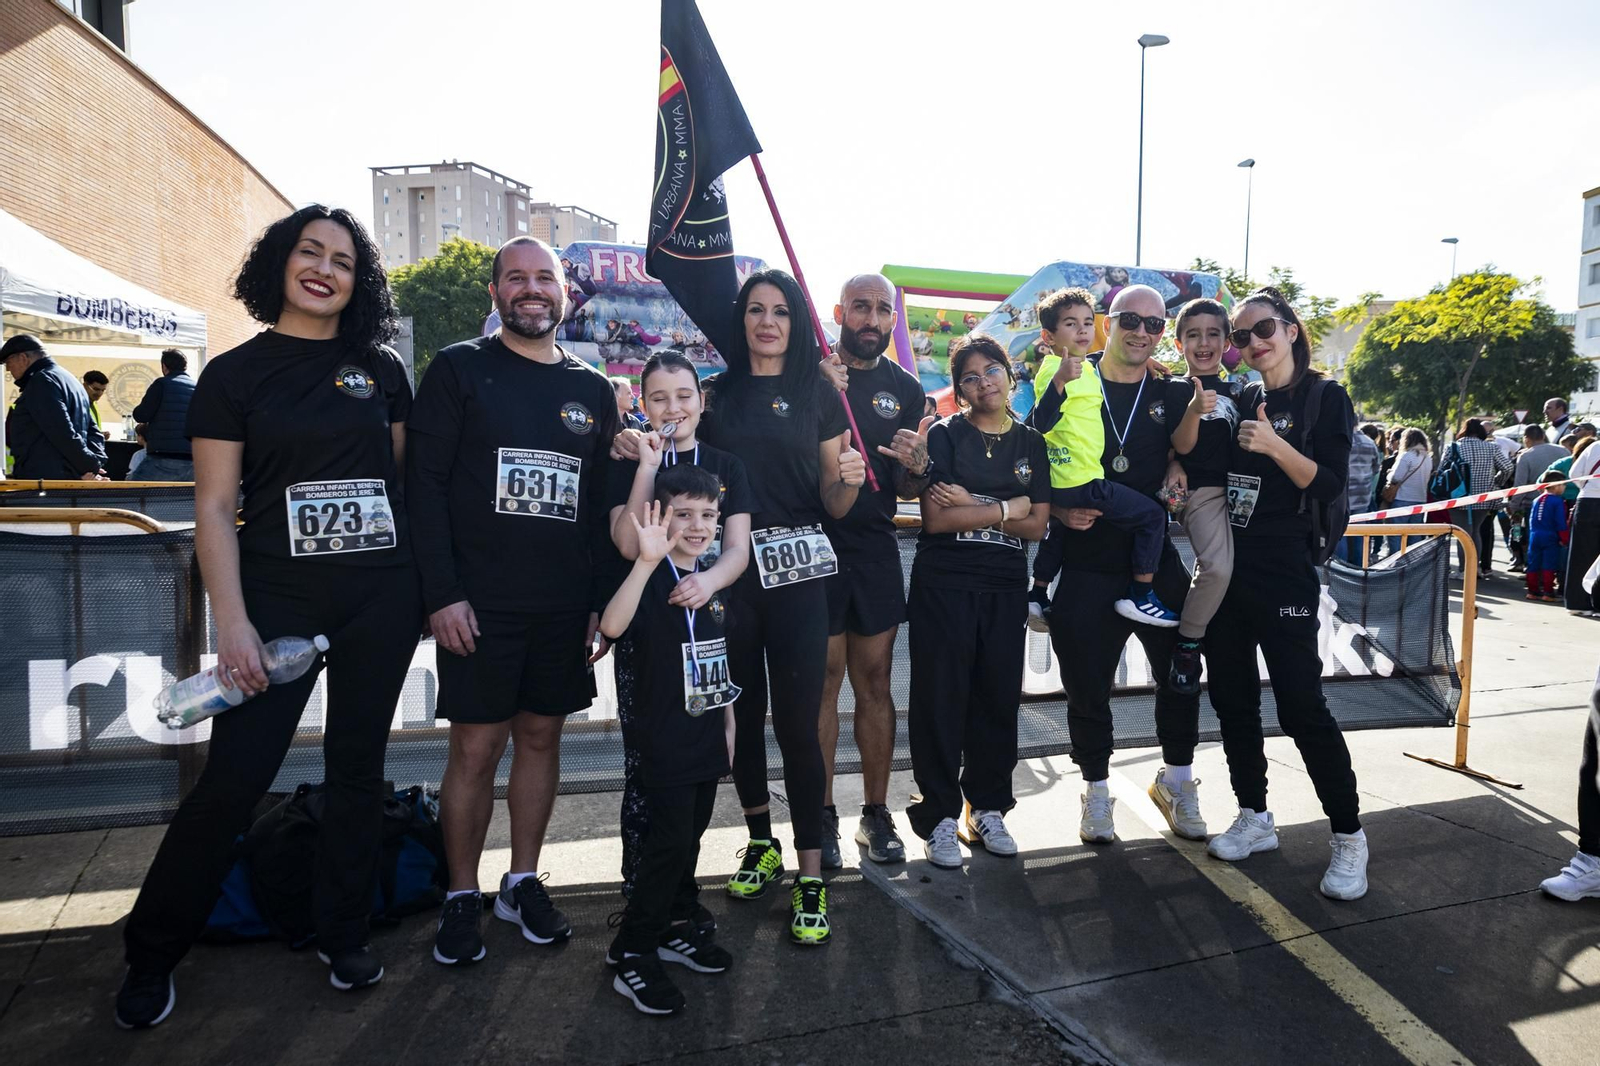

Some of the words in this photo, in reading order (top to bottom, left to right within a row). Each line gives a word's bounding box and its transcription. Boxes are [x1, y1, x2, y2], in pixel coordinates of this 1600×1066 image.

[672, 103, 688, 145] MMA
[657, 161, 688, 220] URBANA
[502, 451, 533, 459] CARRERA
[533, 453, 558, 462] INFANTIL
[515, 458, 551, 467] BOMBEROS
[291, 485, 326, 493] CARRERA
[326, 483, 357, 491] INFANTIL
[507, 467, 558, 502] 631
[305, 491, 348, 499] BOMBEROS
[297, 501, 363, 537] 623
[765, 532, 796, 543] BOMBEROS
[761, 539, 812, 573] 680
[1280, 606, 1310, 617] FILA
[686, 644, 712, 653] CRRERA
